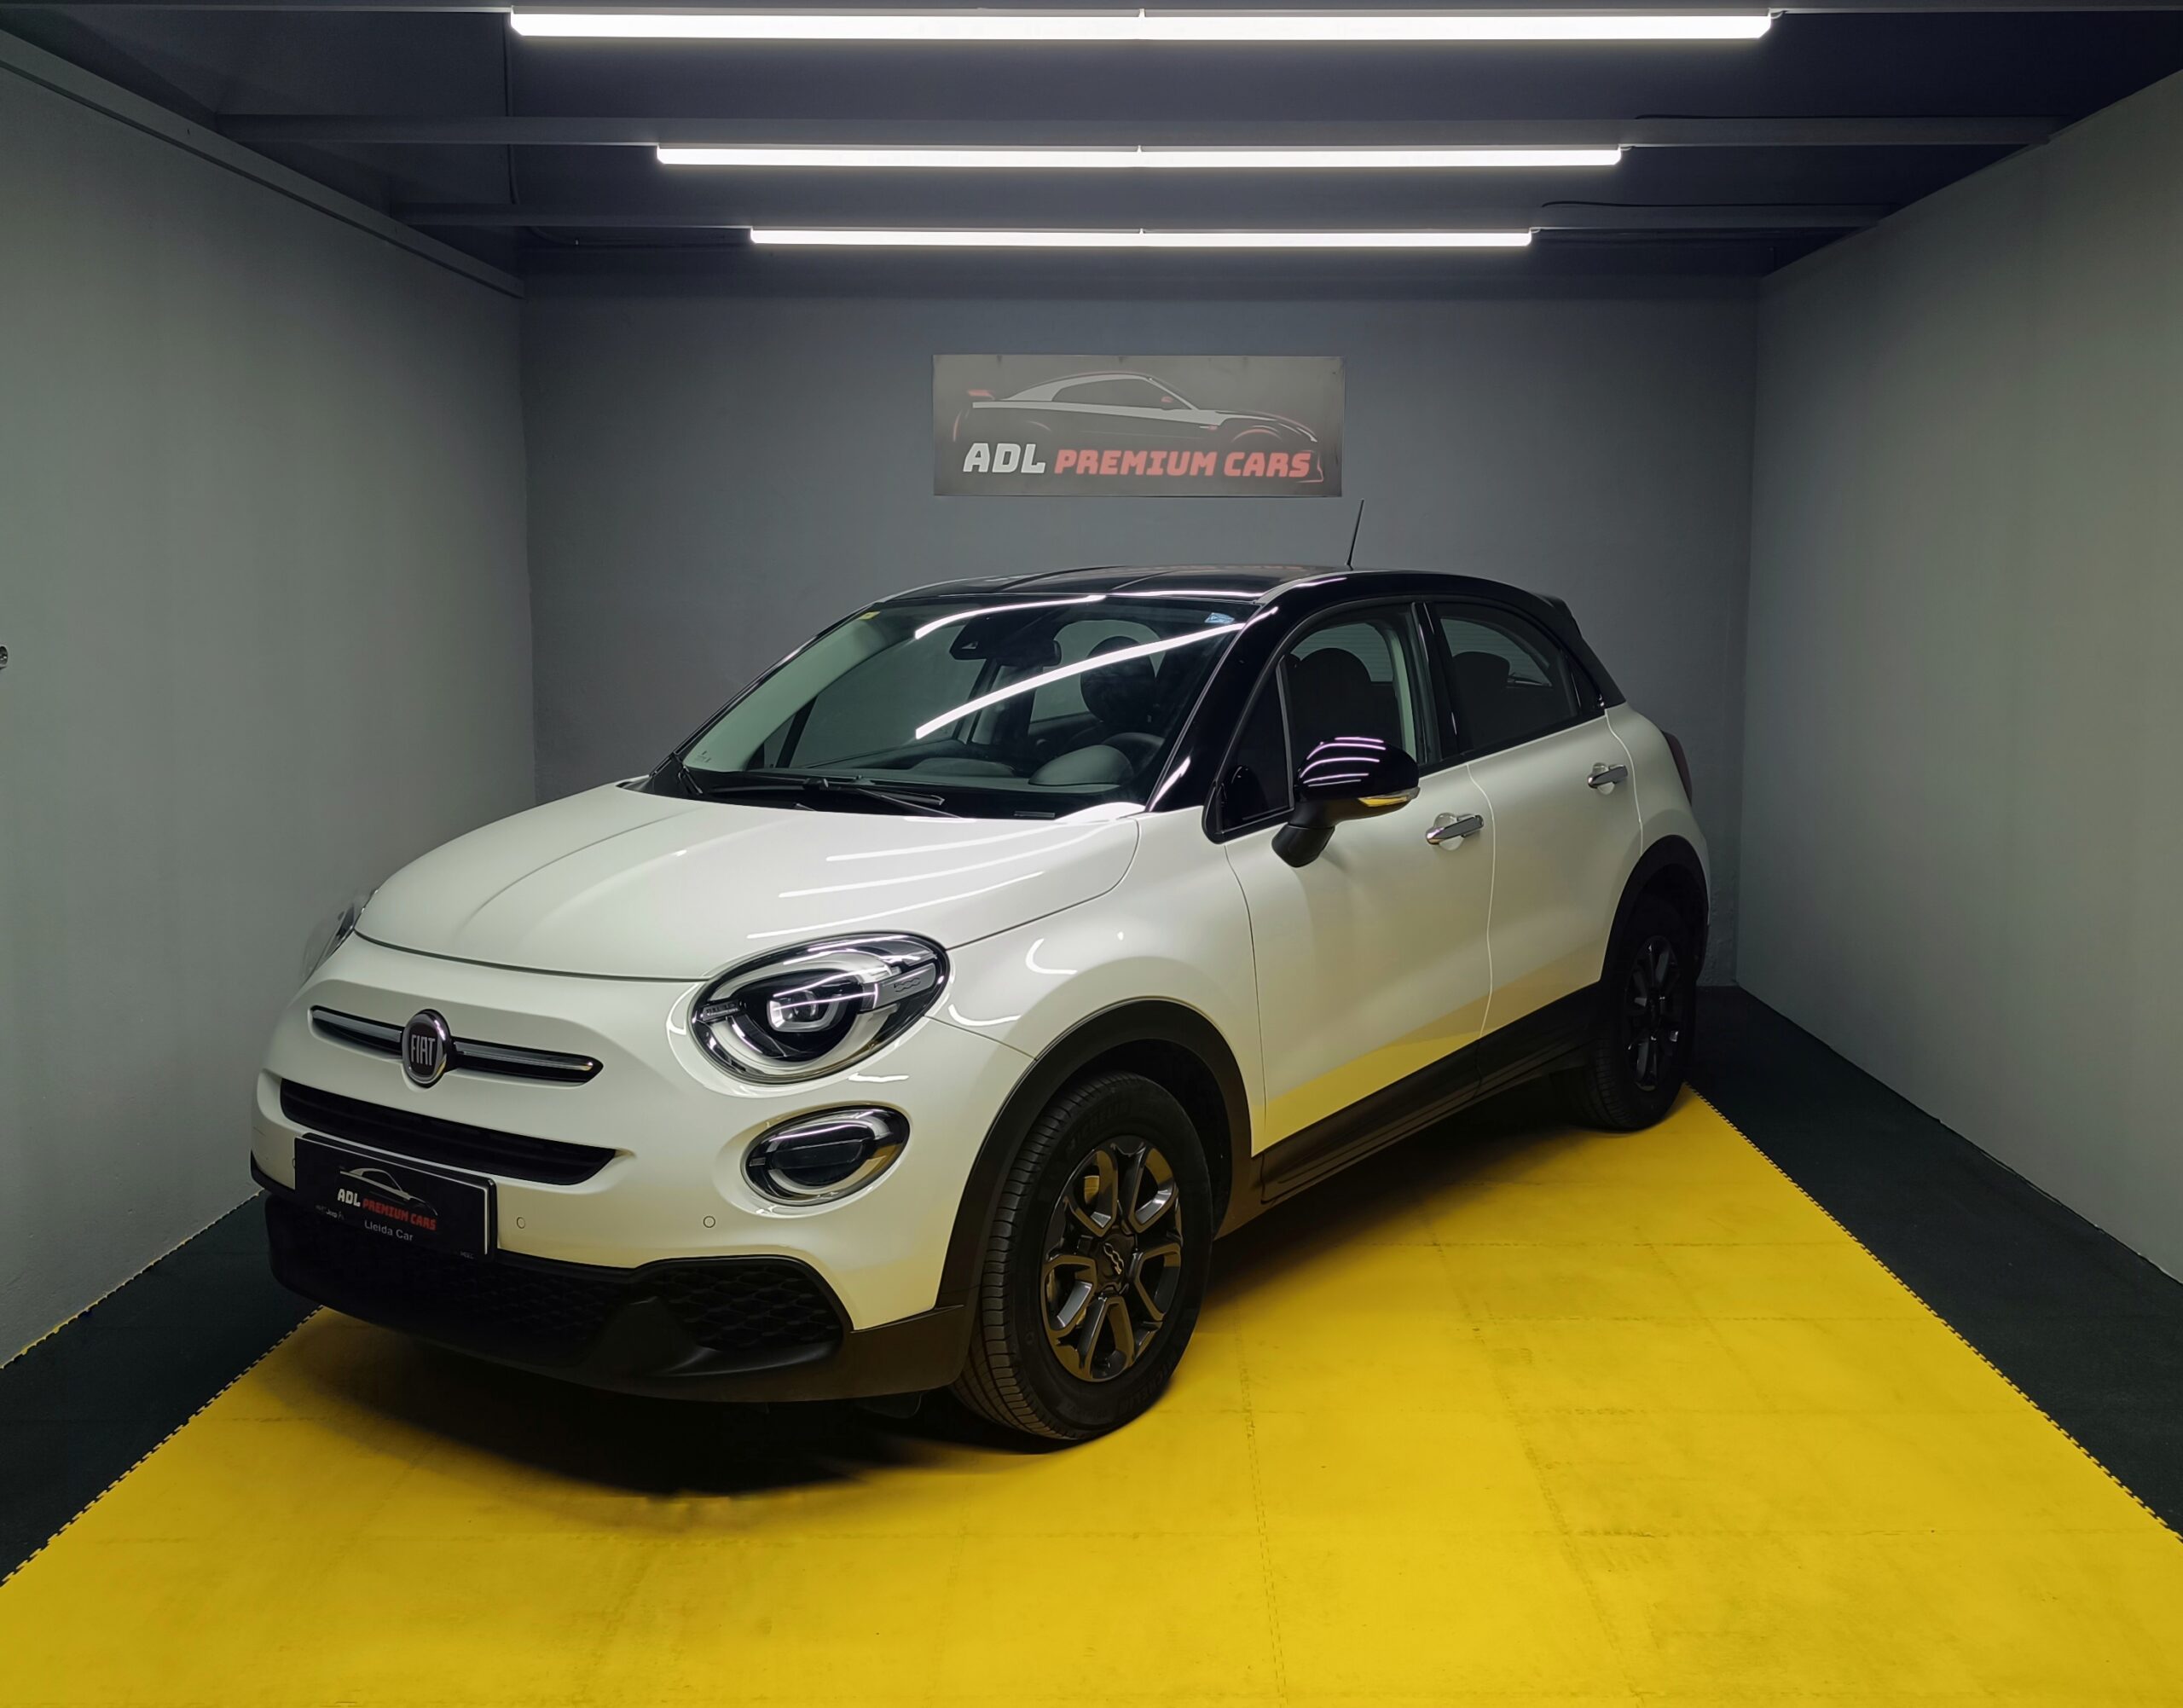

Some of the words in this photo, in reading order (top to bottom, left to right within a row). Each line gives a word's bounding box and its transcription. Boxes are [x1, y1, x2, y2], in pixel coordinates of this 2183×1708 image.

[962, 442, 1045, 474] ADL
[1054, 449, 1217, 477] PREMIUM
[1224, 451, 1312, 478] CARS
[410, 1034, 436, 1066] FIAT
[337, 1188, 361, 1208] ADL
[362, 1198, 409, 1222] PREMIUM
[410, 1213, 437, 1232] CARS
[364, 1219, 394, 1237] Lleida
[396, 1229, 414, 1242] Car
